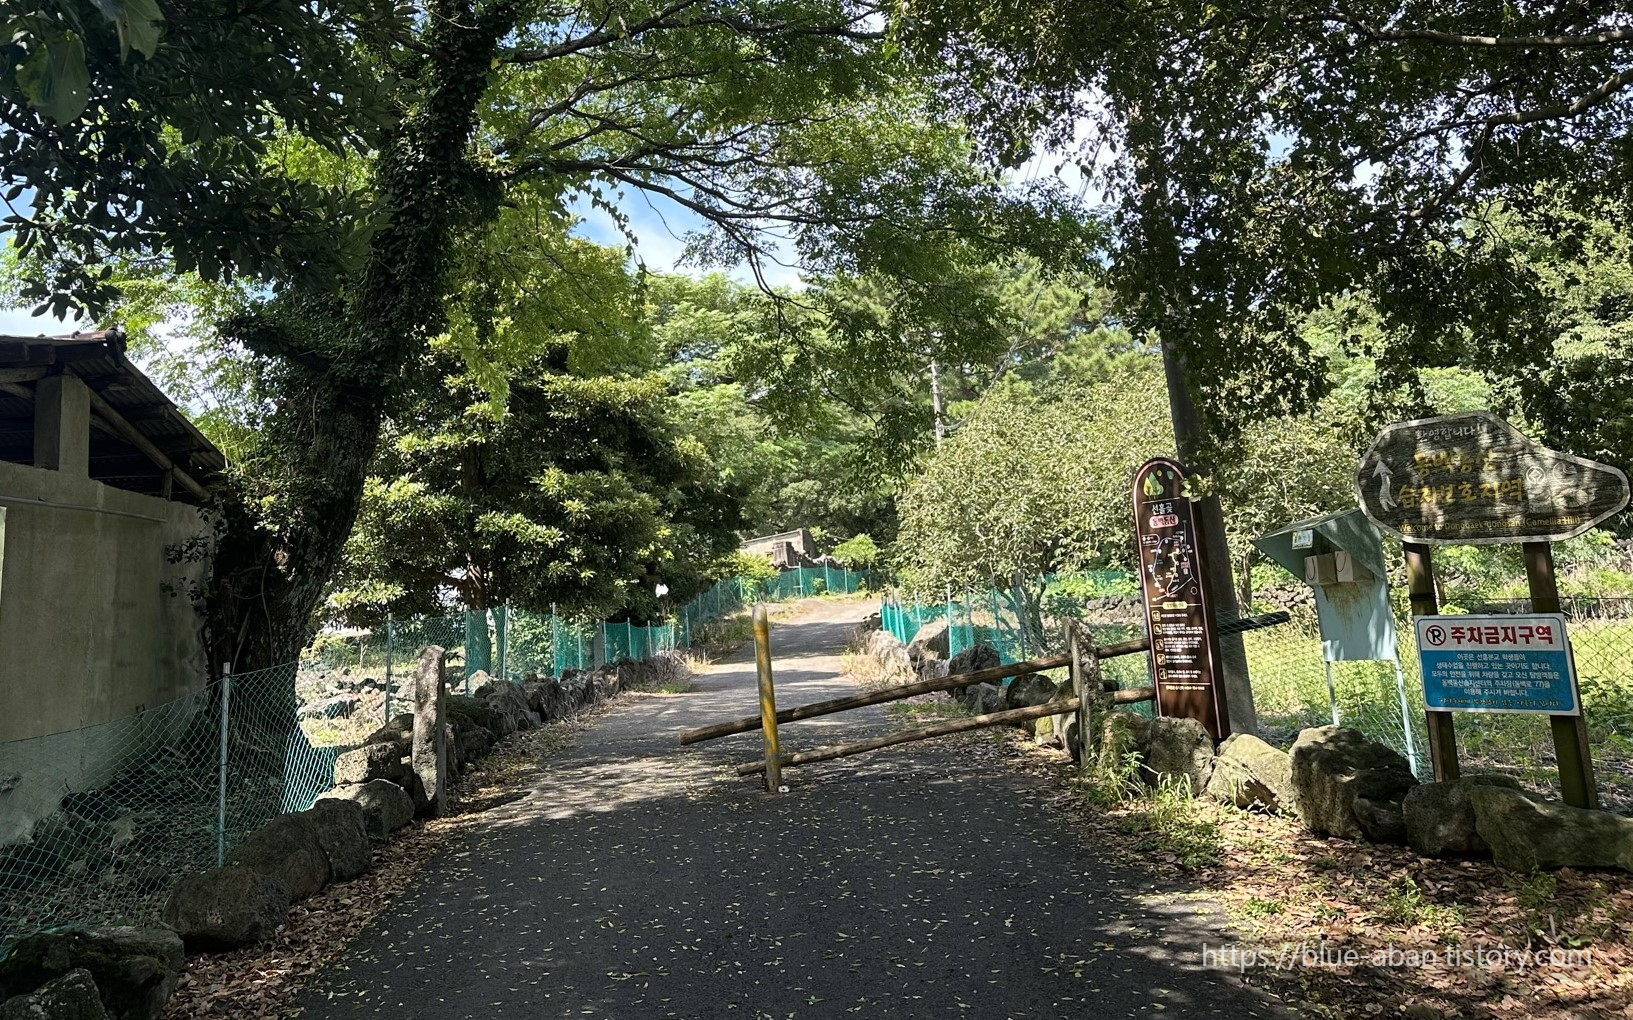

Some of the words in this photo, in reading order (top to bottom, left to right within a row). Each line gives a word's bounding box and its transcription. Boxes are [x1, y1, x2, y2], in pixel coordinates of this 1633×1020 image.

[1399, 479, 1522, 509] 습지보호지역
[1399, 522, 1433, 533] Welcome
[1562, 515, 1581, 525] Hill)
[1450, 625, 1553, 645] 주차금지구역
[1468, 670, 1481, 678] 위해
[1515, 671, 1528, 679] 오신
[1491, 662, 1504, 670] 있는
[1505, 662, 1529, 670] 곳이기도
